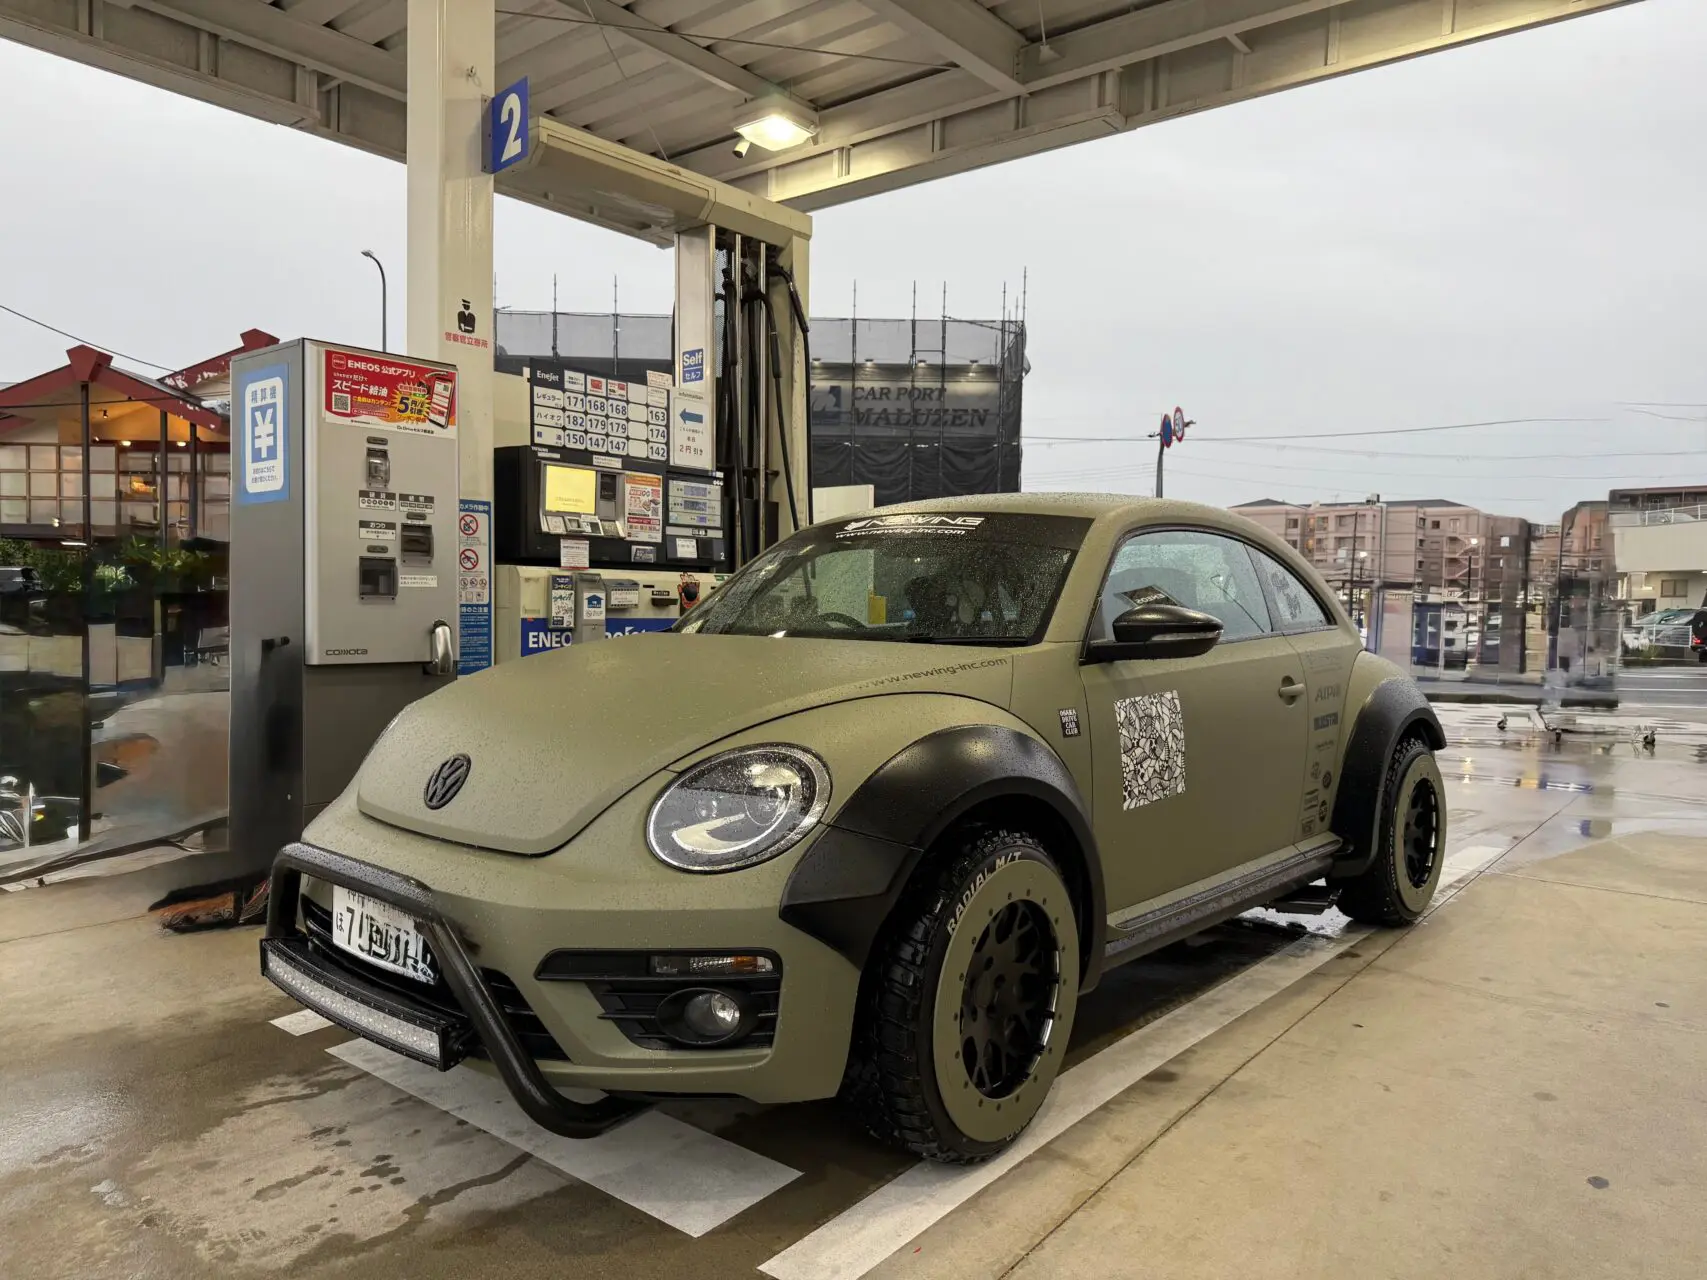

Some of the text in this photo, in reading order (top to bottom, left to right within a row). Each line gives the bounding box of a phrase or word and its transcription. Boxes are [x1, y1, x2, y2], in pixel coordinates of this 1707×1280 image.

[500, 92, 521, 162] 2
[683, 352, 703, 366] Self
[348, 360, 416, 378] ENEOS 公式アプリ
[536, 370, 559, 382] EneJet
[685, 371, 702, 381] セルフ
[333, 379, 388, 397] スピード給油
[853, 386, 947, 401] CAR PORT
[397, 396, 410, 414] 5
[536, 393, 666, 422] レギュラー 171 168 168 163
[854, 407, 990, 428] MALUZEN
[536, 412, 666, 441] ハイオク 182 179 179 174
[566, 432, 585, 446] 150
[588, 436, 606, 450] 147
[609, 439, 626, 452] 147
[649, 446, 666, 459] 142
[835, 528, 966, 539] www.newing-inc.com
[720, 551, 726, 560] 2
[1061, 715, 1078, 723] DRIVE
[1065, 721, 1076, 729] CAR
[1065, 727, 1079, 735] CLUB
[947, 851, 1022, 936] RADIAL M/T
